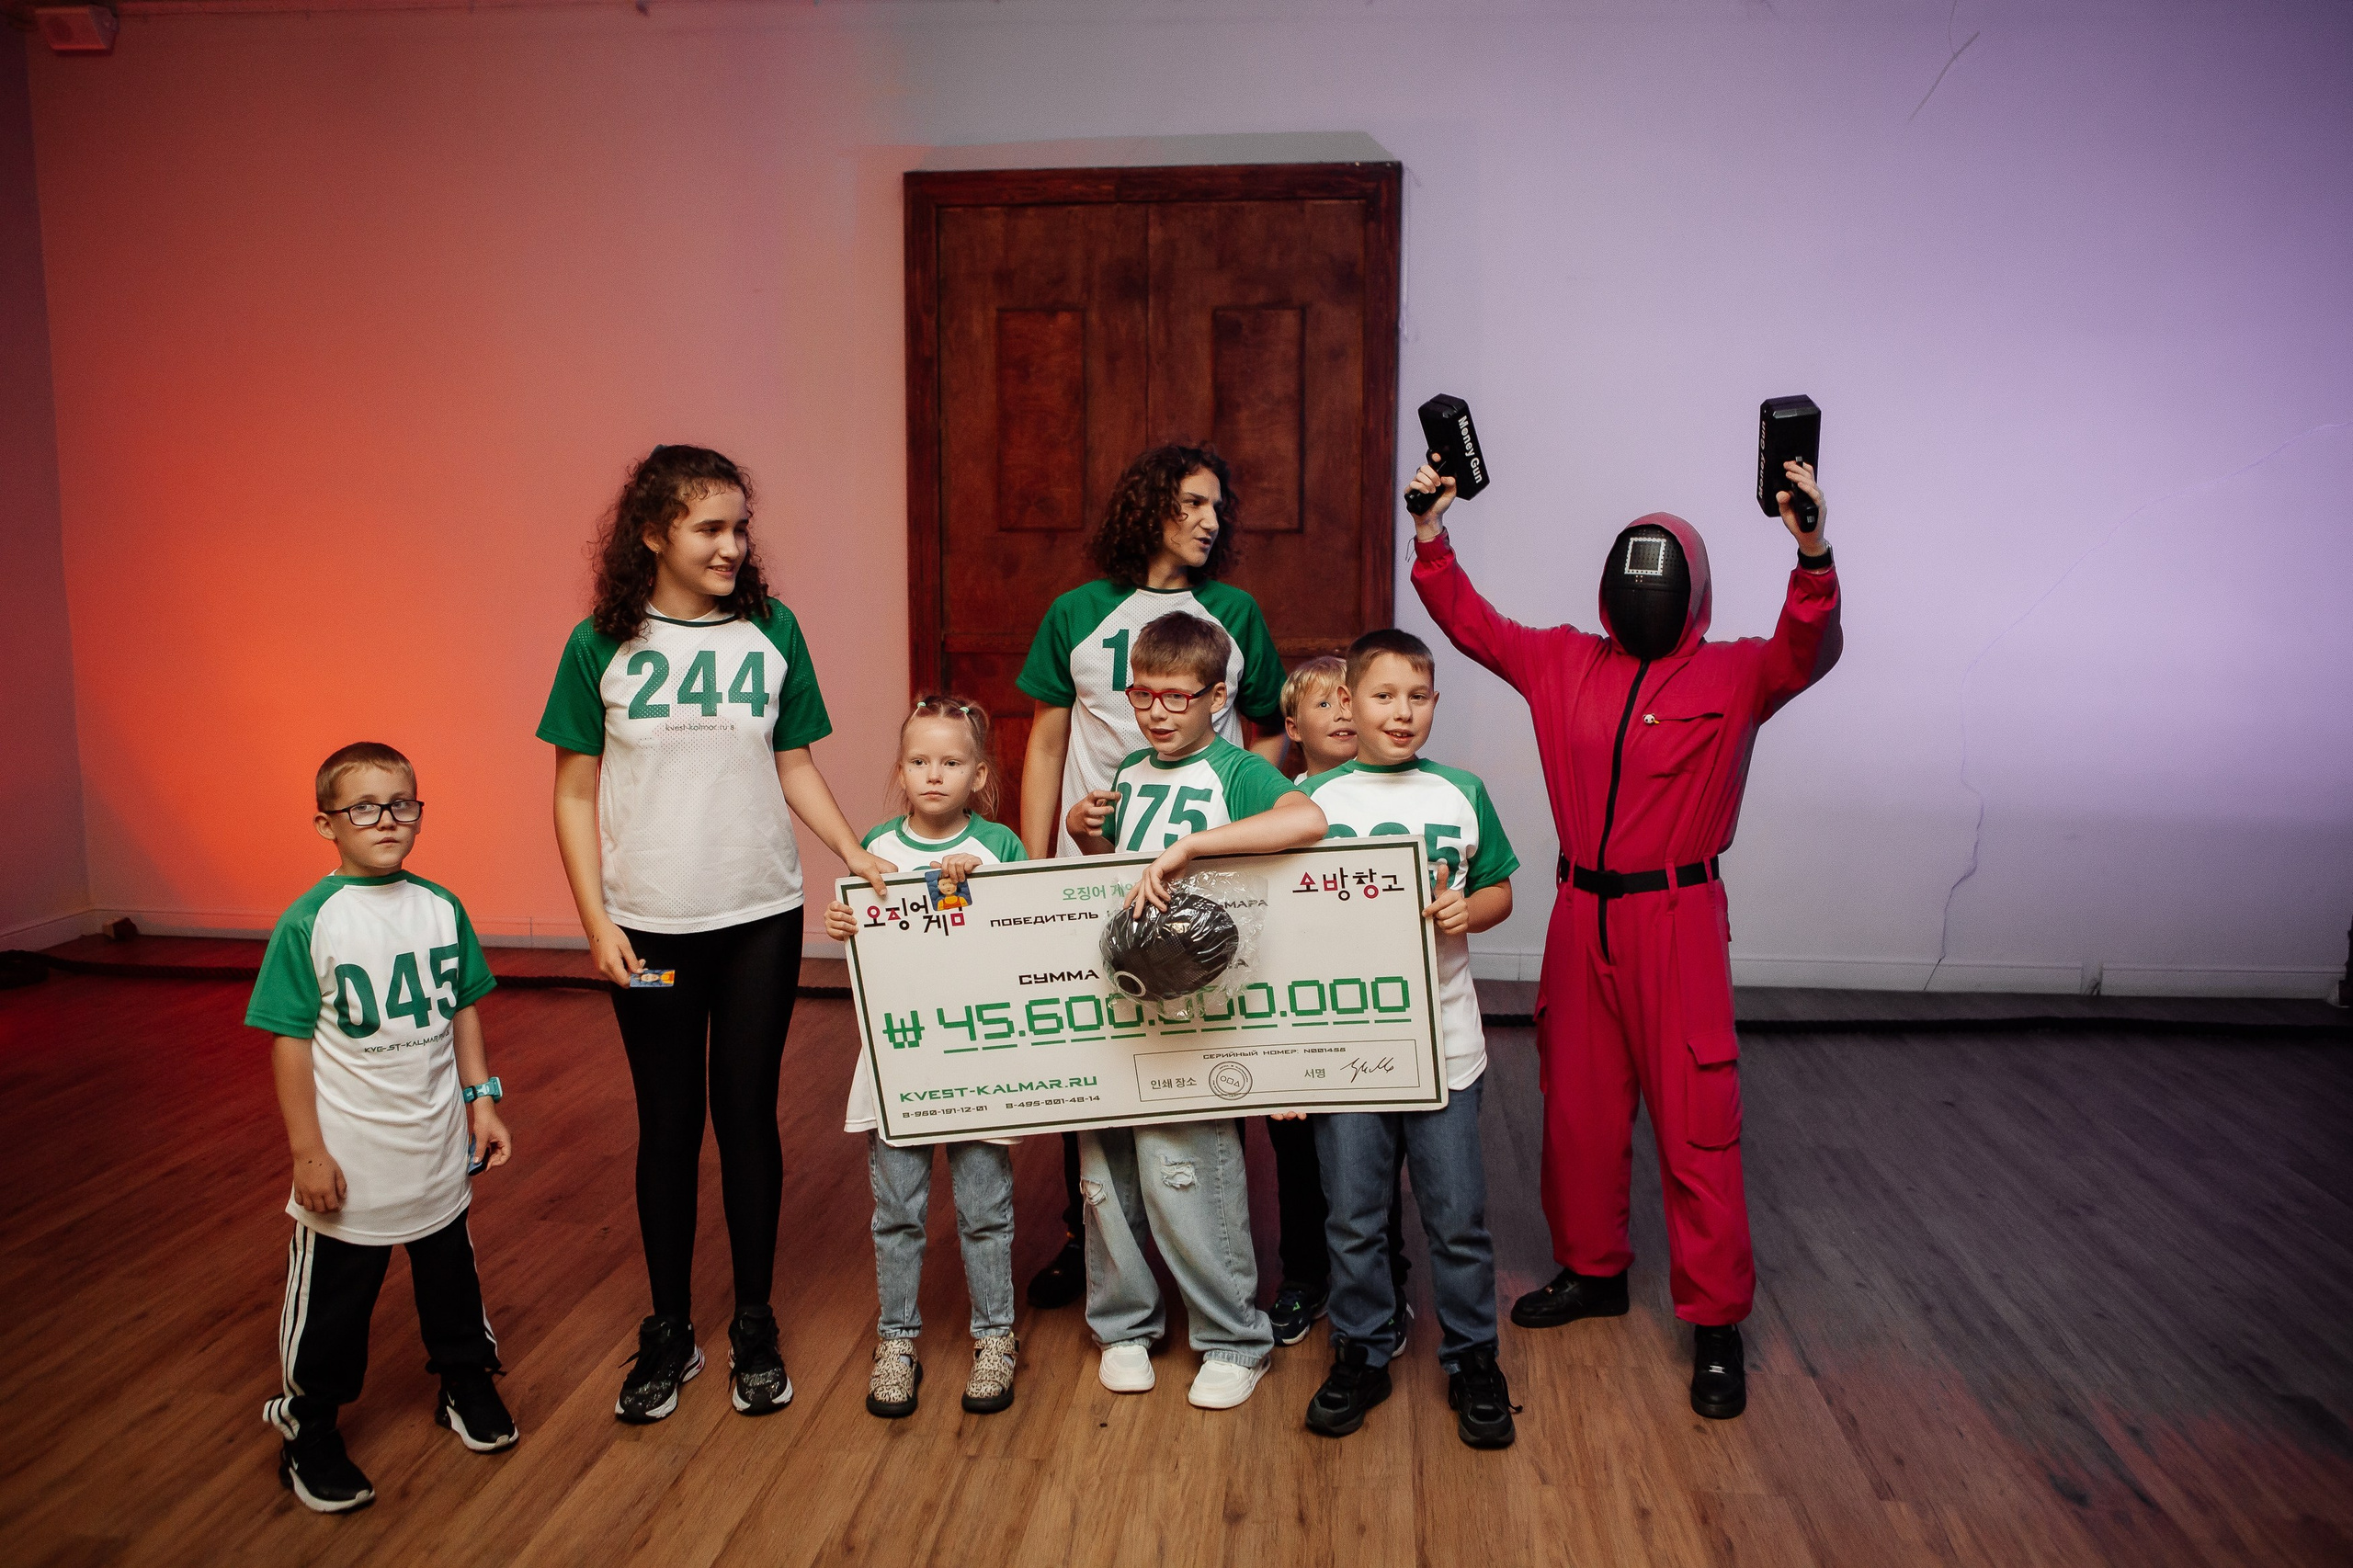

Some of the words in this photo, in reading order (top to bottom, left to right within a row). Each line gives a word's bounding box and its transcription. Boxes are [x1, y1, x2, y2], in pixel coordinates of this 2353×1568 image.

[1458, 415, 1475, 457] Money
[1470, 457, 1483, 483] Gun
[626, 649, 770, 720] 244
[1062, 884, 1107, 902] 오징어
[1292, 867, 1405, 902] 소방창고
[863, 894, 929, 931] 오징어
[990, 911, 1099, 927] ПОБЕДИТЕЛЬ
[1018, 969, 1100, 985] СУММА
[333, 943, 460, 1040] 045
[1202, 1050, 1258, 1060] СЕРИЙНЫЙ
[1262, 1048, 1300, 1056] НОМЕР:
[1150, 1077, 1173, 1090] 인쇄
[1175, 1076, 1198, 1088] 장소
[1304, 1067, 1326, 1079] 서명
[899, 1075, 1098, 1103] KVEST-KALMAR.RU
